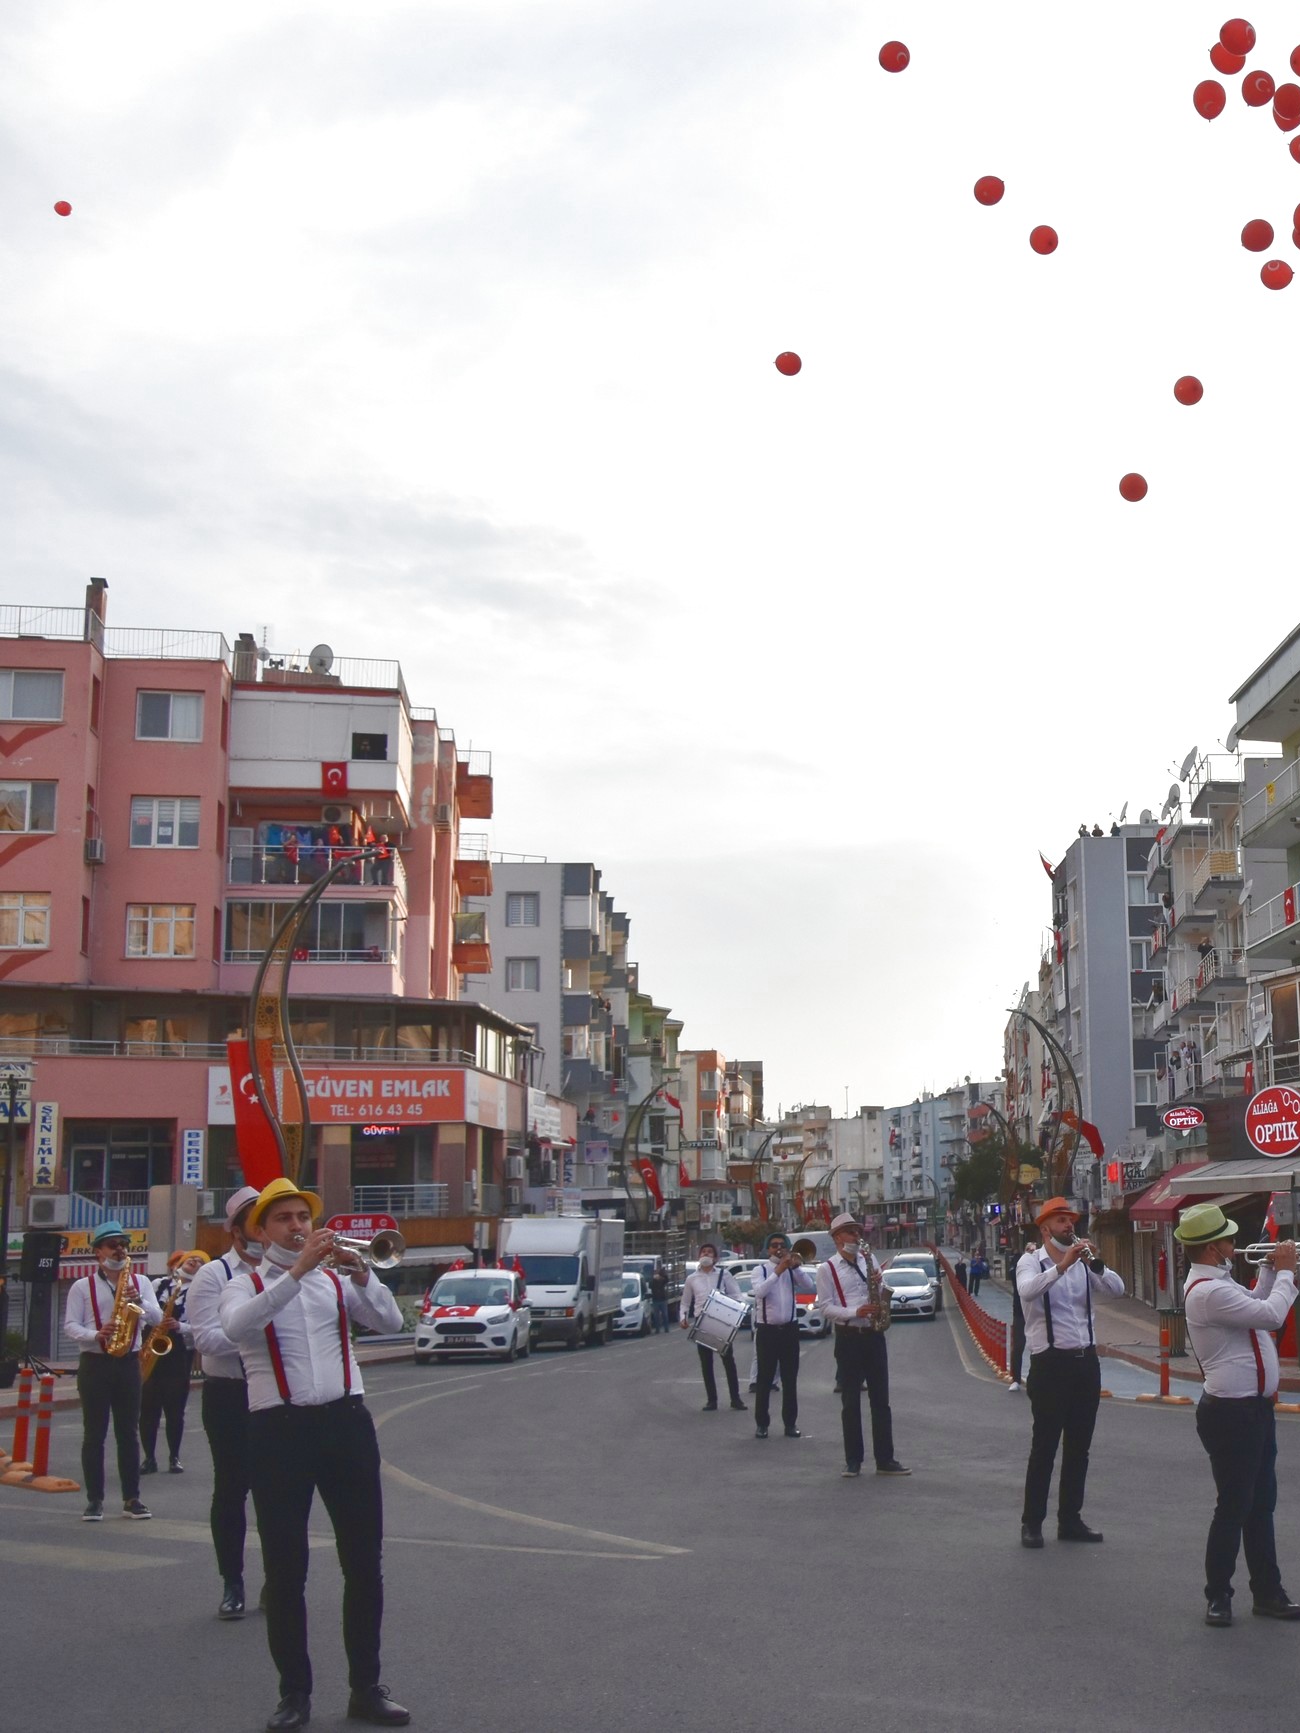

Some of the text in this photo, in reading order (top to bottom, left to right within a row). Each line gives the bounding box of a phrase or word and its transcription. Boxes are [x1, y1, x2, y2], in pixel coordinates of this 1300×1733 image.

[305, 1076, 450, 1097] GÜVEN EMLAK
[330, 1104, 423, 1116] TEL: 616 43 45
[1252, 1099, 1278, 1115] ALİAĞA
[1169, 1115, 1199, 1126] OPTİK
[1255, 1116, 1298, 1144] OPTİK
[36, 1137, 53, 1185] EMLAK
[187, 1132, 201, 1179] BERBER
[351, 1218, 372, 1228] CAN
[38, 1258, 53, 1267] JEST
